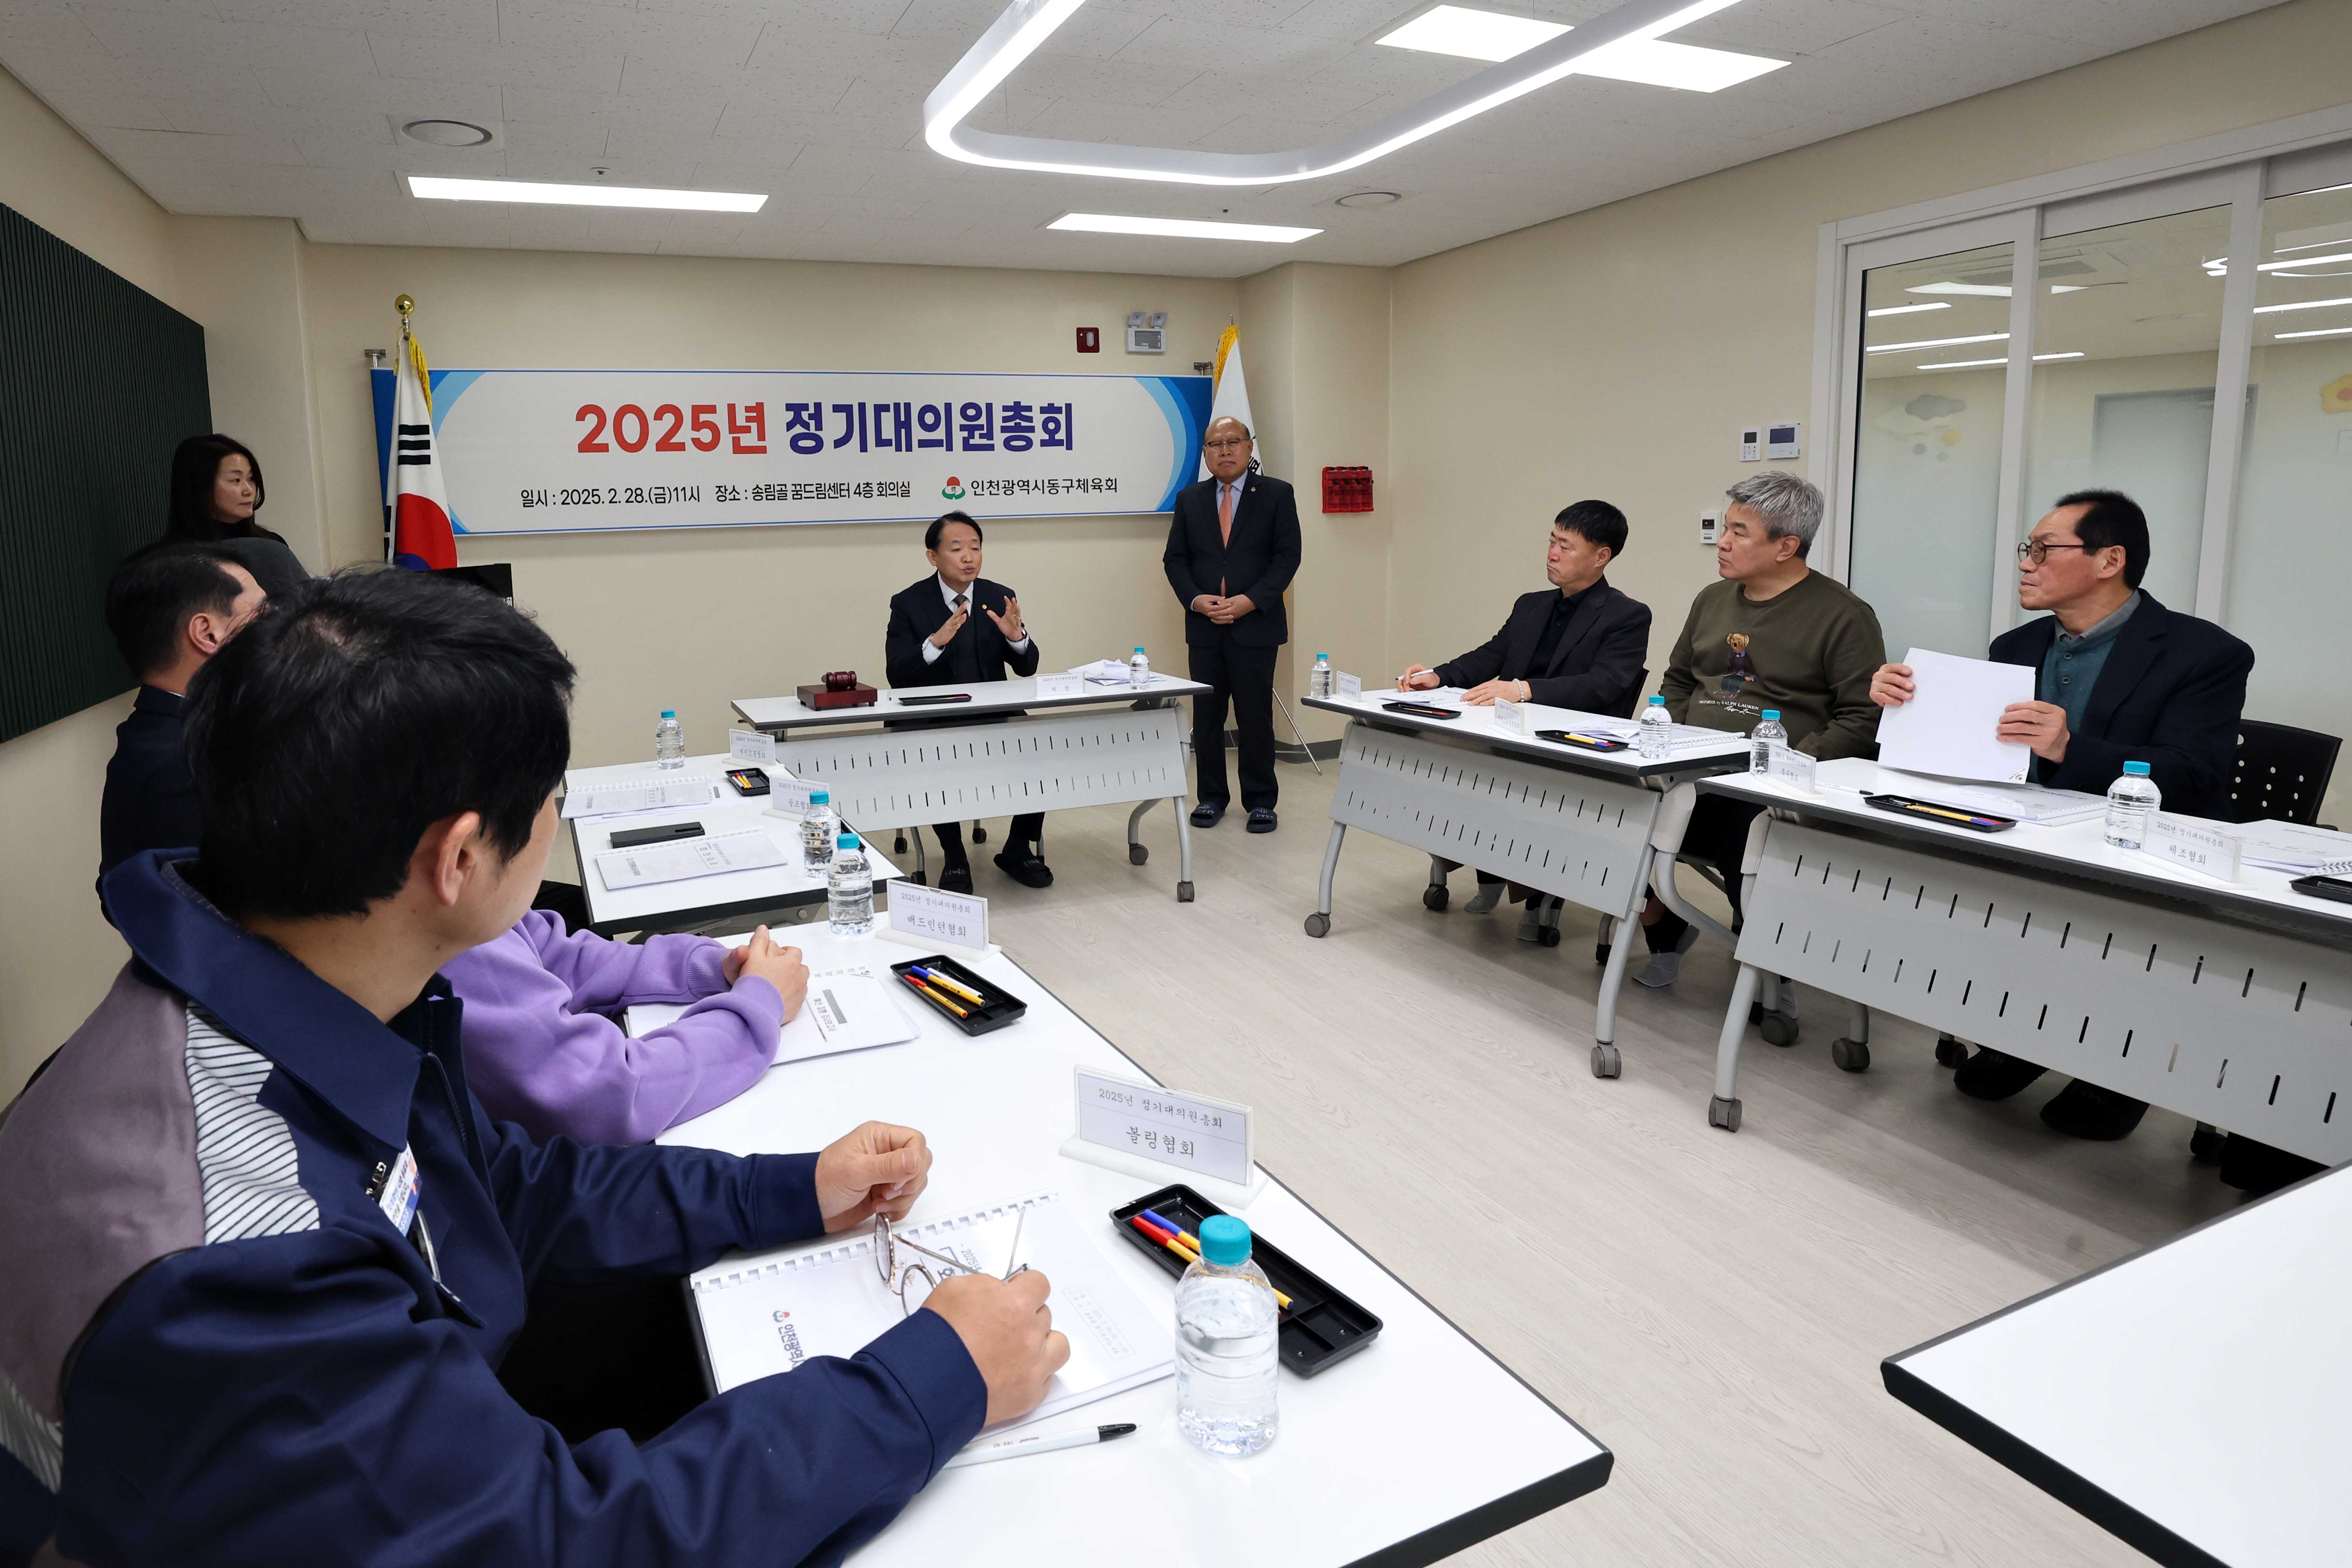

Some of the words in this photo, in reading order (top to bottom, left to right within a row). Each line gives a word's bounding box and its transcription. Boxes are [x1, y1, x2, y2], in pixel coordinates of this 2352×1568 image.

[575, 402, 767, 454] 2025년
[786, 401, 1073, 455] 정기대의원총회
[521, 489, 548, 508] 일시
[560, 488, 604, 505] 2025.
[608, 488, 621, 504] 2.
[625, 485, 701, 505] 28.(금)11시
[715, 485, 740, 502] 장소
[752, 483, 788, 501] 송림골
[791, 482, 850, 500] 꿈드림센터
[853, 481, 874, 499] 4층
[877, 481, 911, 498] 회의실
[971, 477, 1118, 496] 인천광역시동구체육회
[2157, 821, 2176, 833] 2025년
[2180, 828, 2223, 848] 정기대의원총회
[2169, 844, 2206, 866] 체조협회
[901, 893, 921, 904] 2025년
[925, 897, 970, 914] 정기대의원총회
[907, 915, 966, 938] 배드민턴협회
[1099, 1088, 1133, 1107] 2025년
[1142, 1099, 1222, 1129] 정기대의원총회
[1126, 1125, 1194, 1158] 볼링협회
